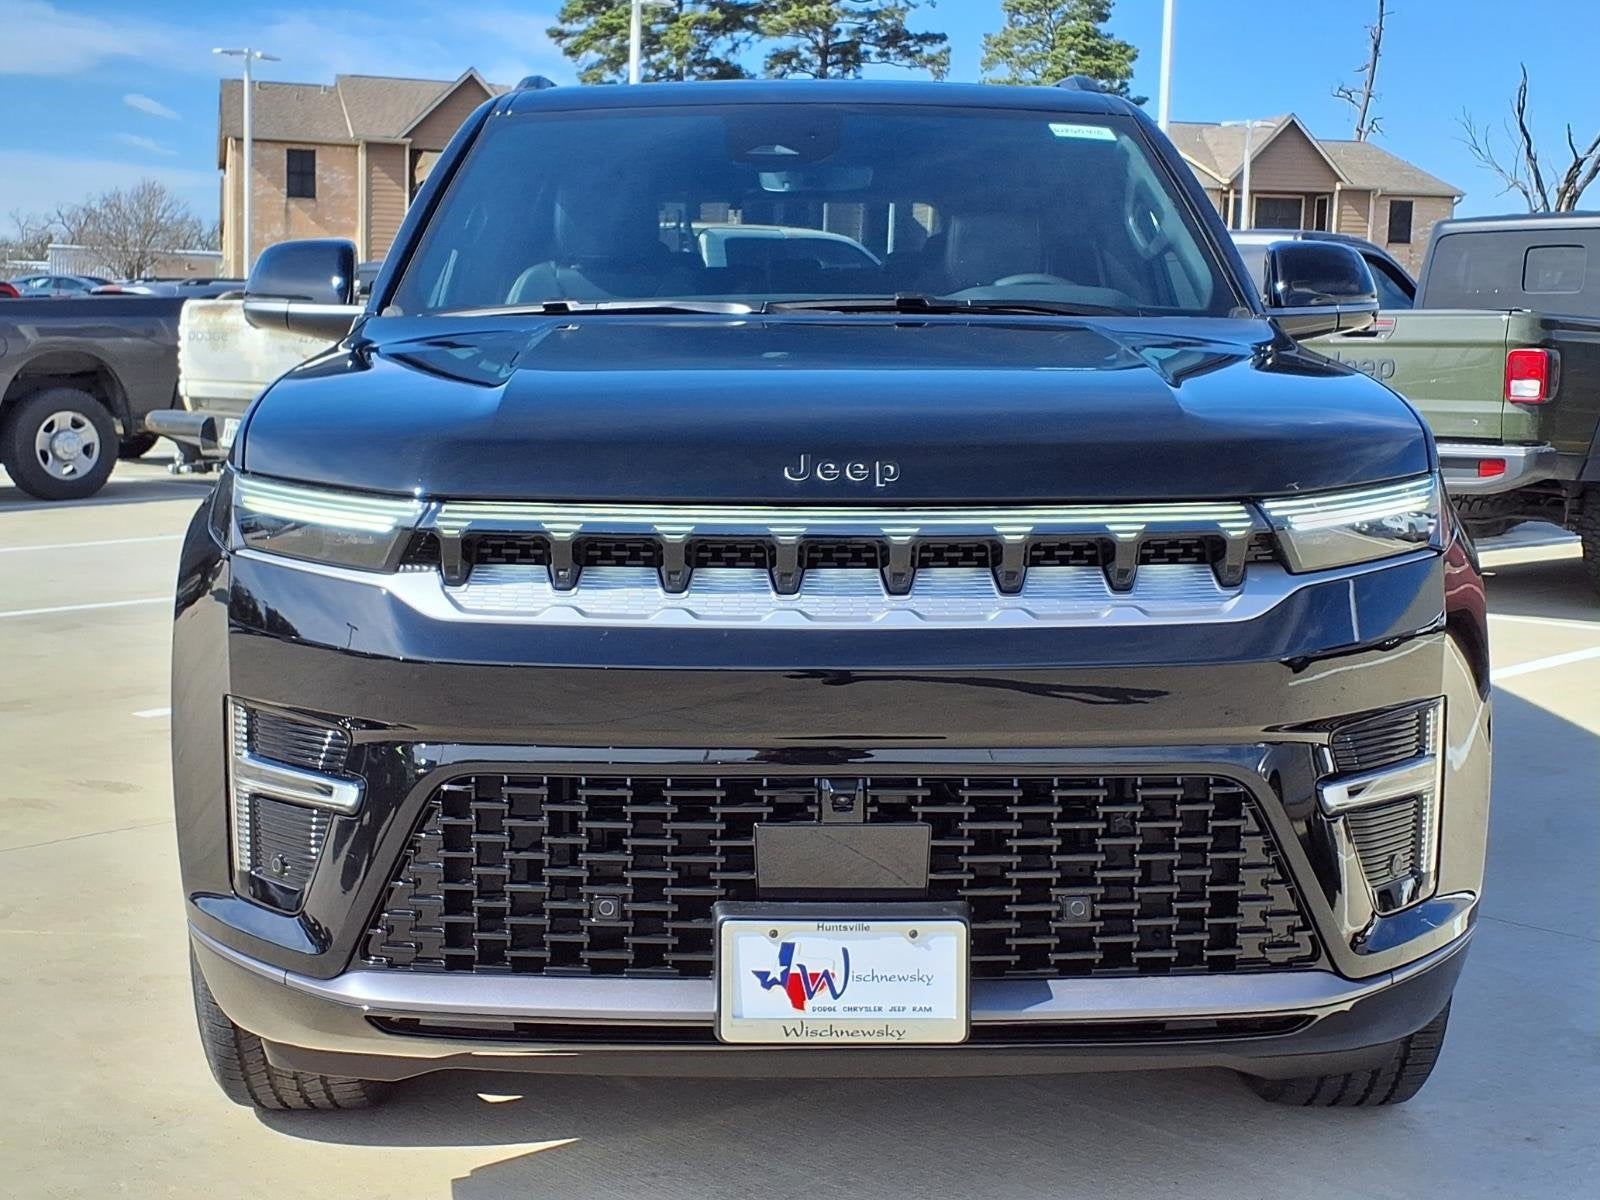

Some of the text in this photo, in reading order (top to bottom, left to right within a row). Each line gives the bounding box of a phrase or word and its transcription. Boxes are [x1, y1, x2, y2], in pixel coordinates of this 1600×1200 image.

[783, 454, 901, 487] Jeep
[816, 922, 871, 932] Huntsville
[797, 946, 934, 1001] Wischnewsky
[811, 1005, 933, 1013] DODGE CHRYSLER JEEP RAM
[781, 1021, 907, 1041] Wischnewsky
